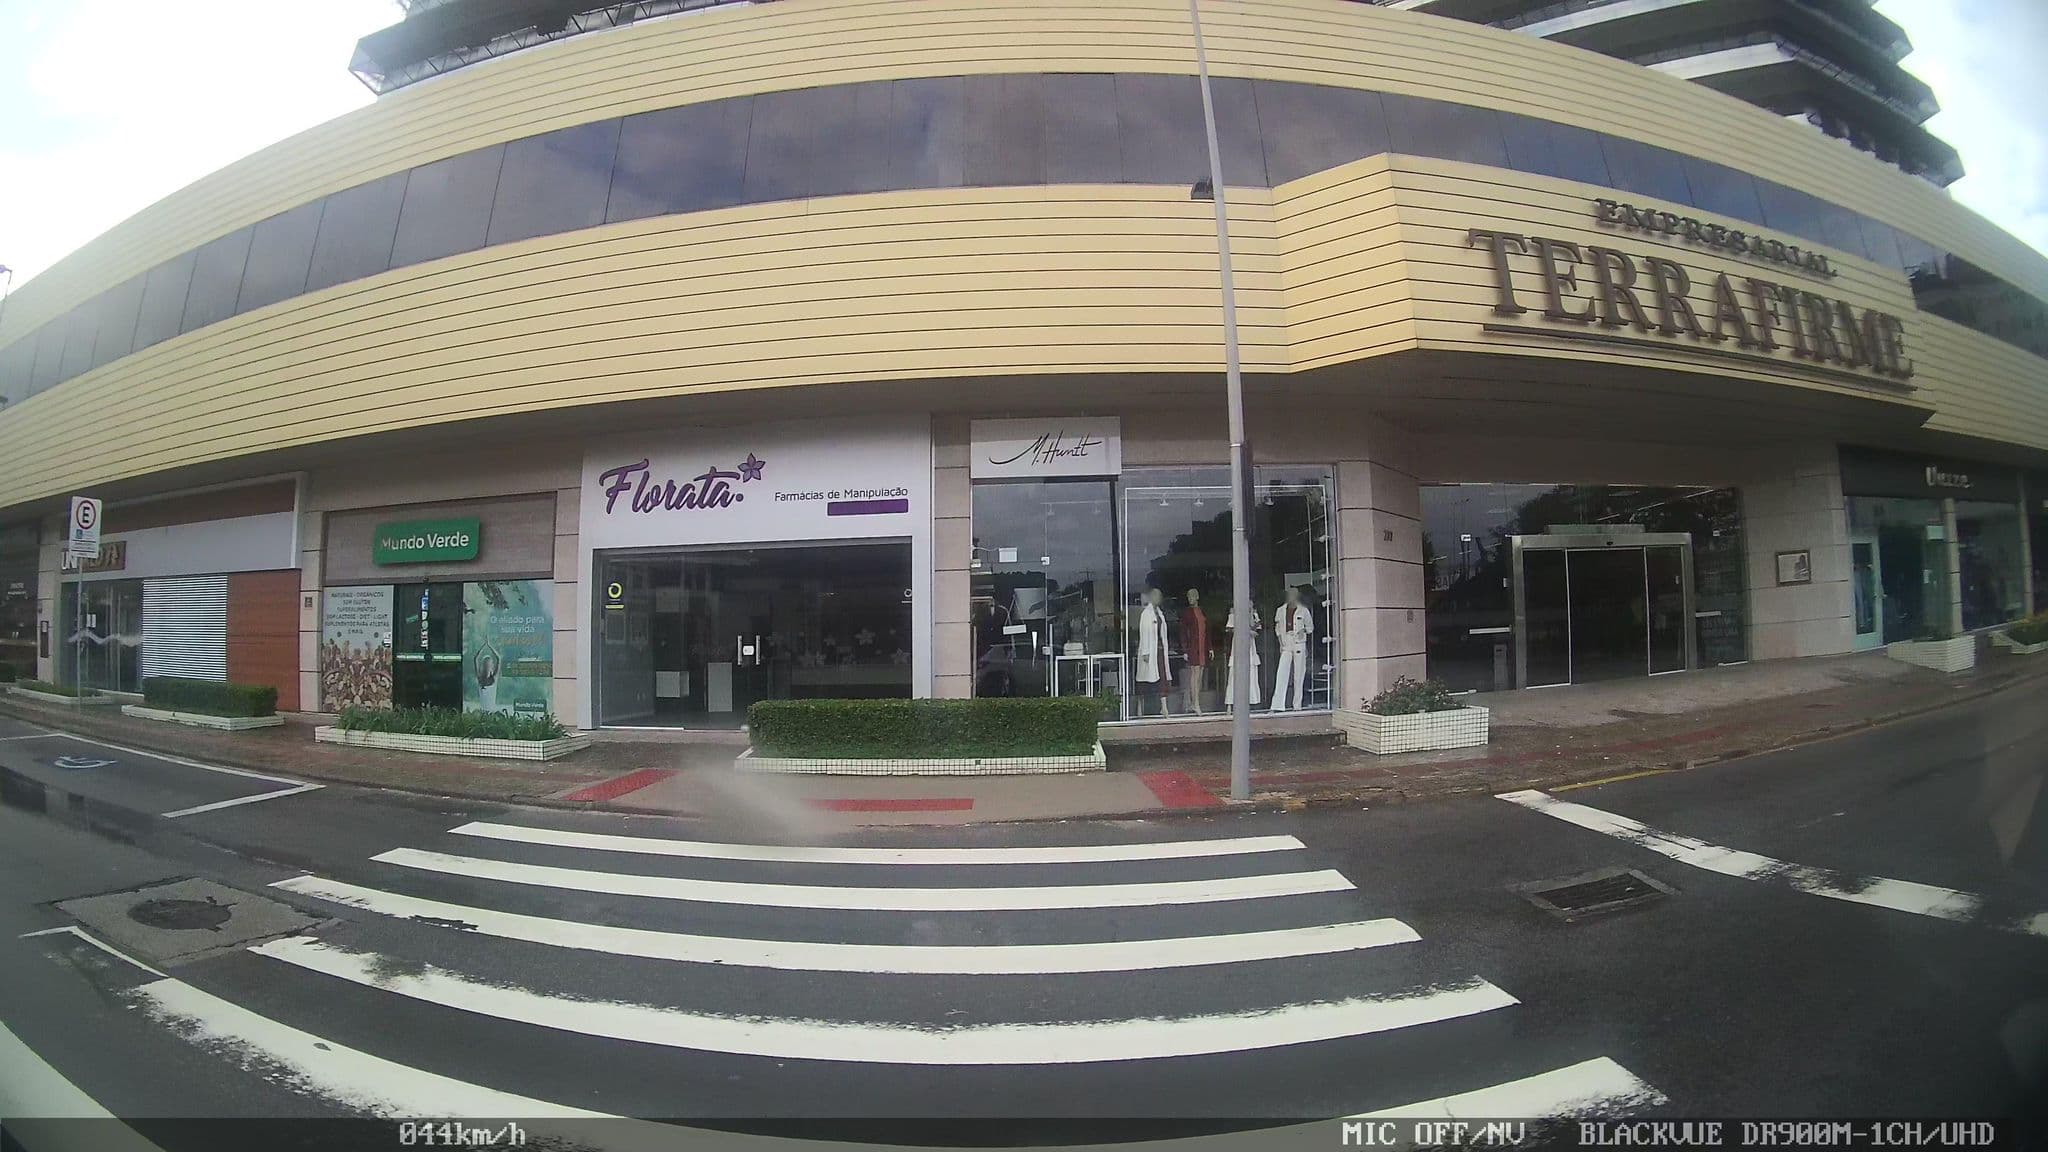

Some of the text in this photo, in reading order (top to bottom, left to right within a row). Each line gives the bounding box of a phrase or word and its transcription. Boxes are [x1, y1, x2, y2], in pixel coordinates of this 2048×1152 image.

[1595, 198, 1838, 277] EMPRESARIAL
[1469, 228, 1914, 377] TERRAFIRME
[827, 489, 840, 499] de
[843, 487, 908, 500] Manipulação
[82, 506, 90, 523] E
[382, 531, 470, 550] Mundo Verde
[517, 625, 536, 633] vida
